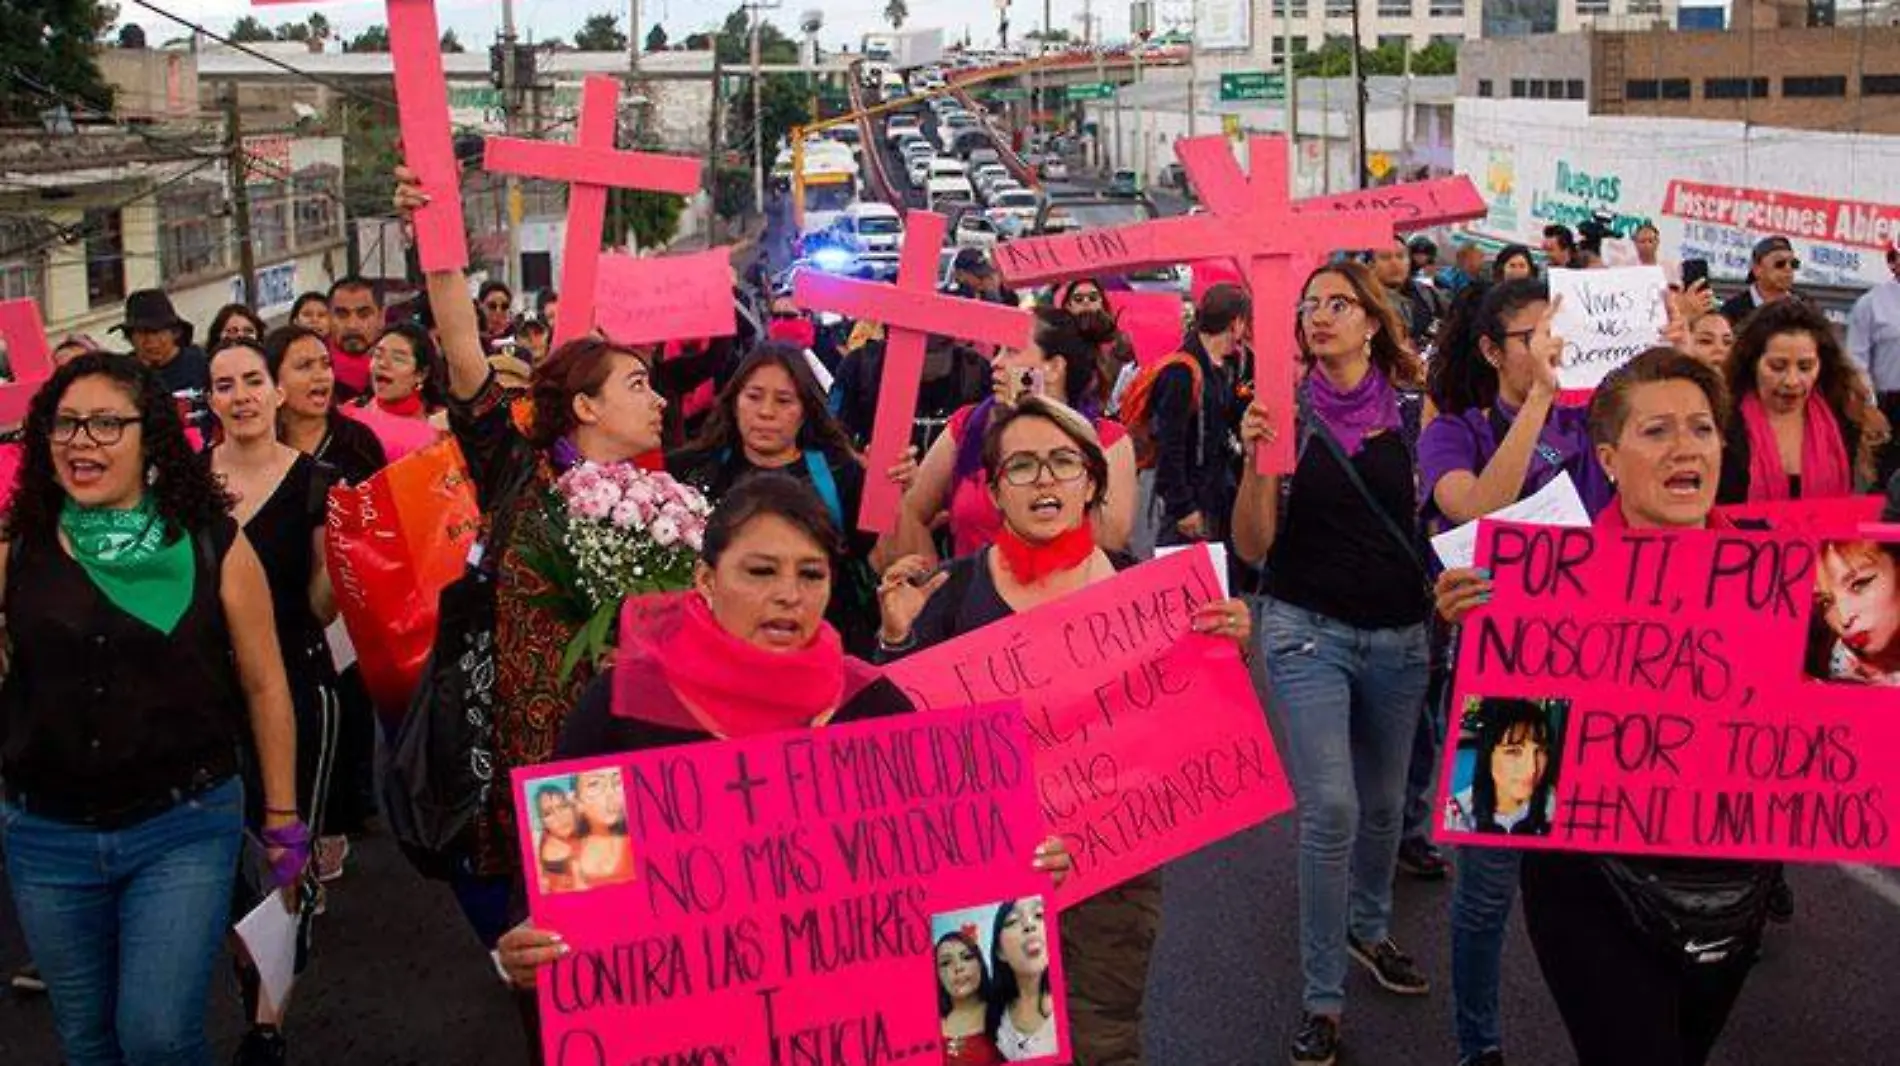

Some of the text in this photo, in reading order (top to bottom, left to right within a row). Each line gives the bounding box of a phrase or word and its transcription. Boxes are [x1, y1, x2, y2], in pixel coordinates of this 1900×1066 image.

[1673, 184, 1828, 237] Inscripciones
[1061, 565, 1213, 672] CRIMEN
[1488, 525, 1815, 620] POR TI, POR
[1477, 614, 1757, 709] NOSOTRAS,
[630, 755, 702, 836] NO
[782, 711, 1023, 820] FEMINICIDIOS
[1576, 710, 1860, 784] POR TODAS
[644, 847, 727, 917] NO
[831, 800, 1016, 883] VIOLENCIA
[1561, 784, 1674, 846] #NI
[1692, 790, 1757, 846] UNA
[550, 887, 931, 1015] CONTRA LAS MUJERES
